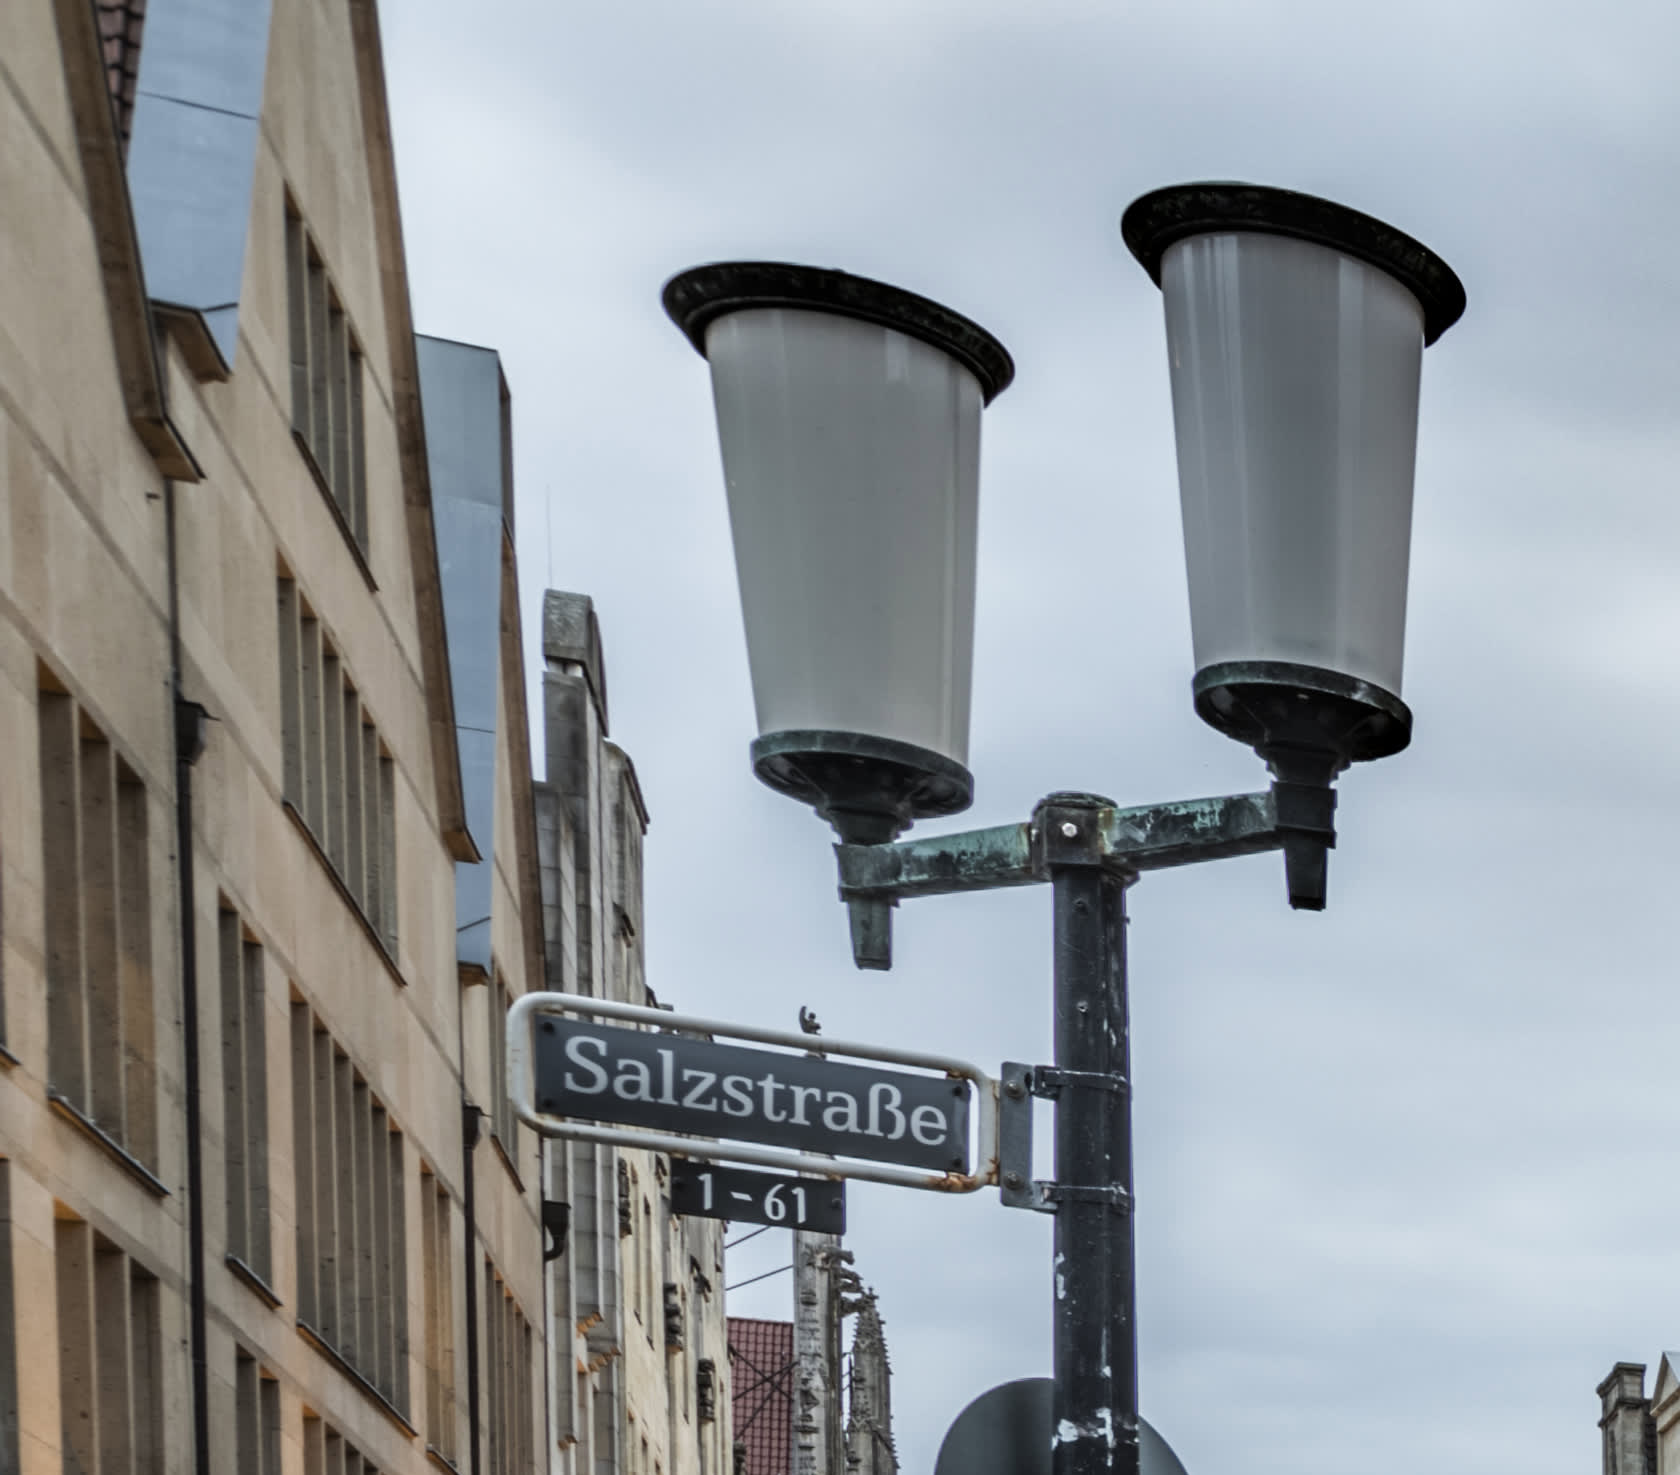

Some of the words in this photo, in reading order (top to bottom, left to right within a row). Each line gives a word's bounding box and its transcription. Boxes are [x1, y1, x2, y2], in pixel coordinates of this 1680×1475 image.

[563, 1036, 948, 1146] Salzstraße
[697, 1173, 713, 1210] 1
[763, 1183, 807, 1224] 61
